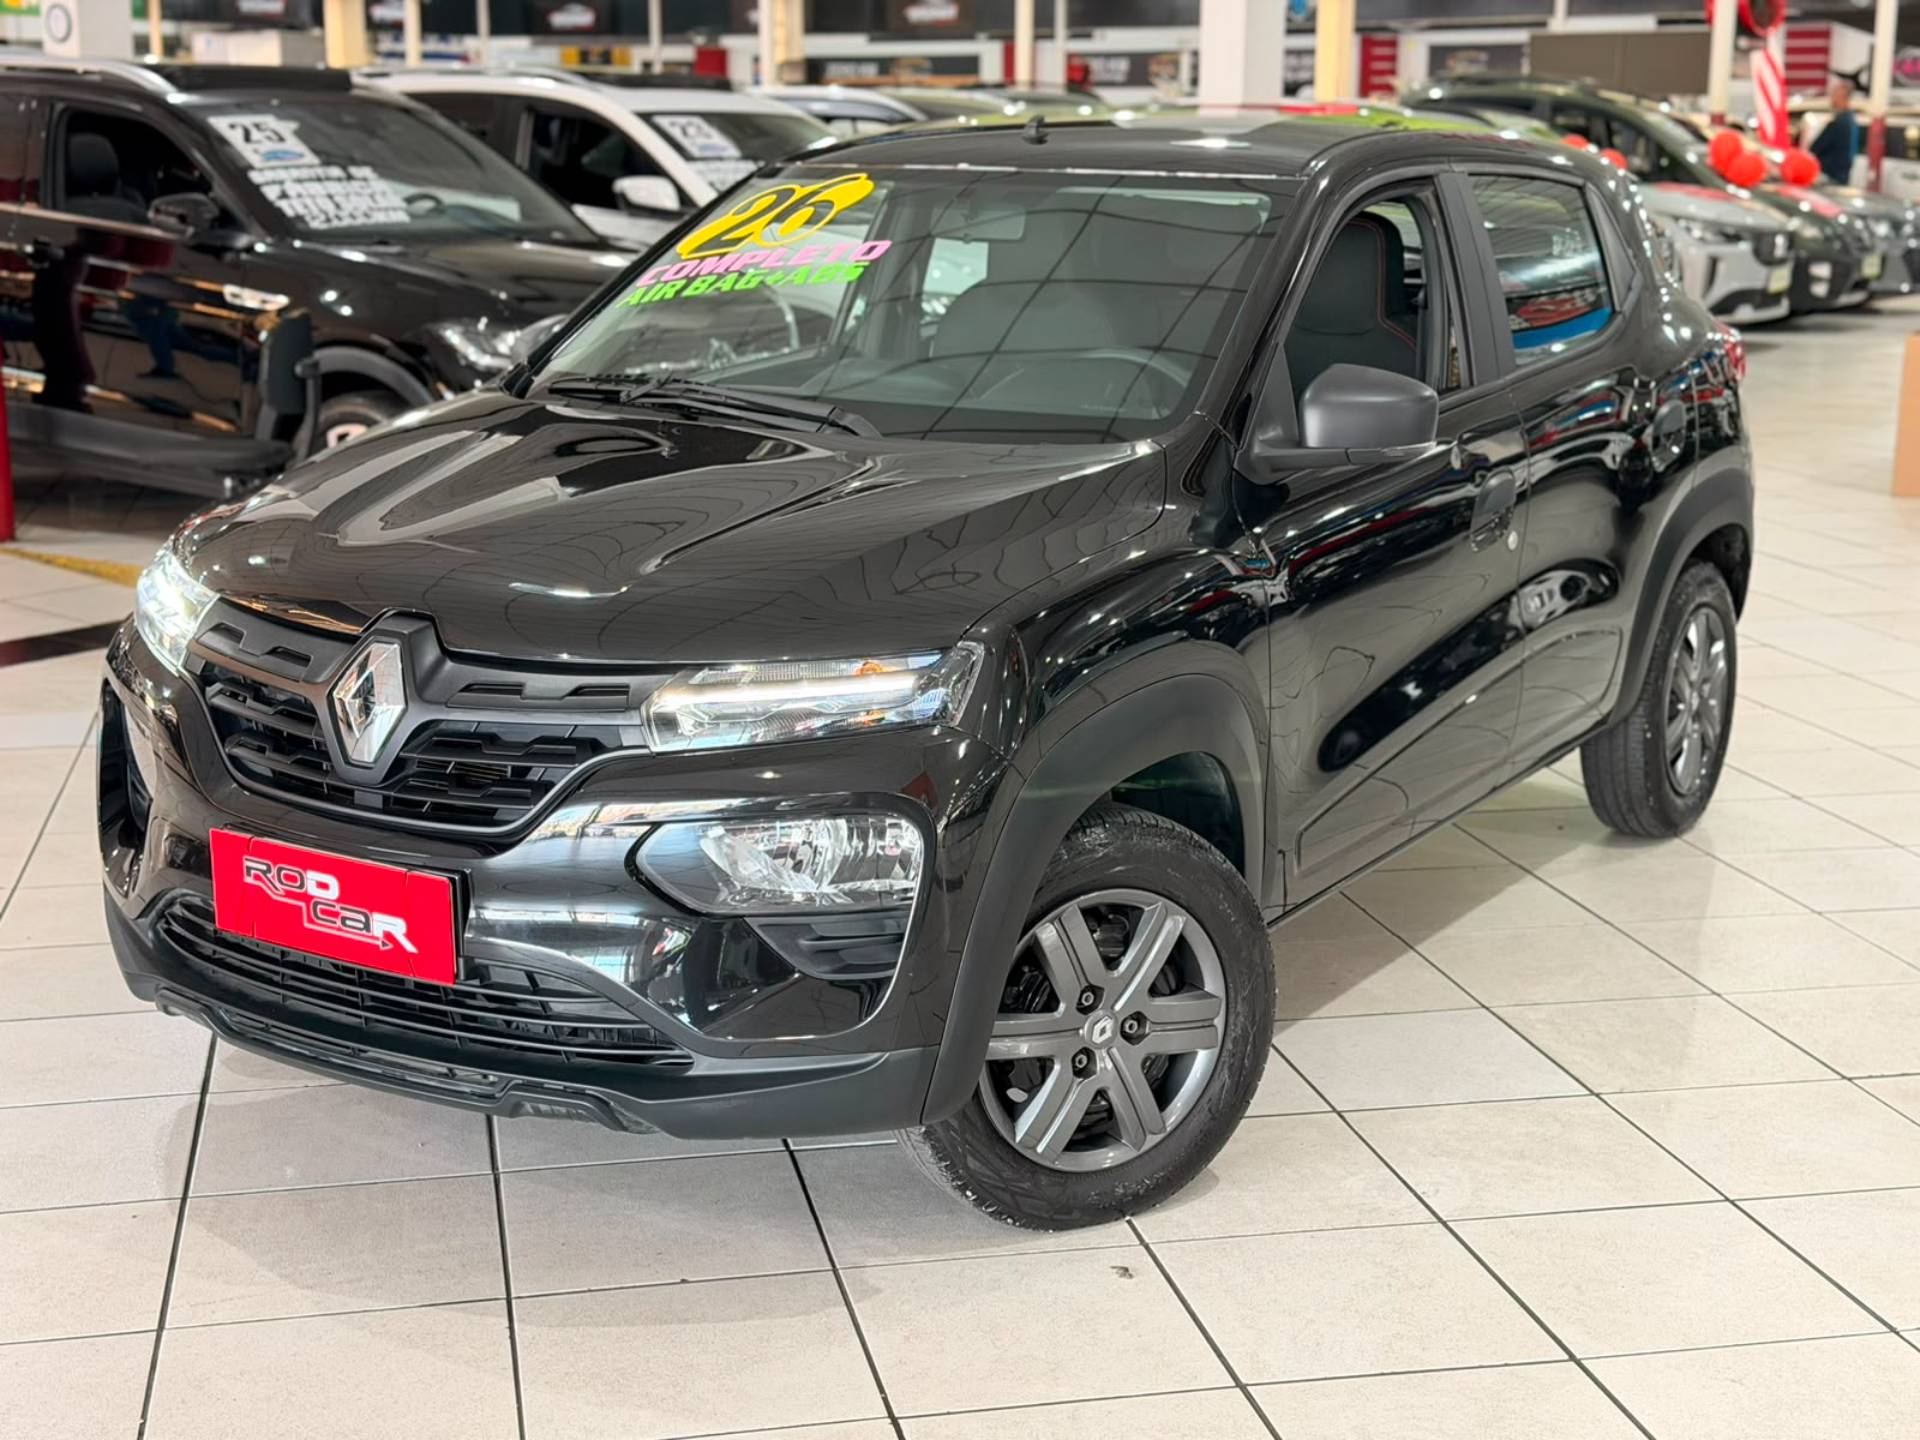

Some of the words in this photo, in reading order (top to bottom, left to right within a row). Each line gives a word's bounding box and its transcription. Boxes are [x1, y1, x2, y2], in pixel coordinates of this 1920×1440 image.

[228, 121, 286, 144] 25
[676, 173, 875, 260] 26
[636, 239, 893, 287] COMPLETO
[615, 279, 687, 308] AIR
